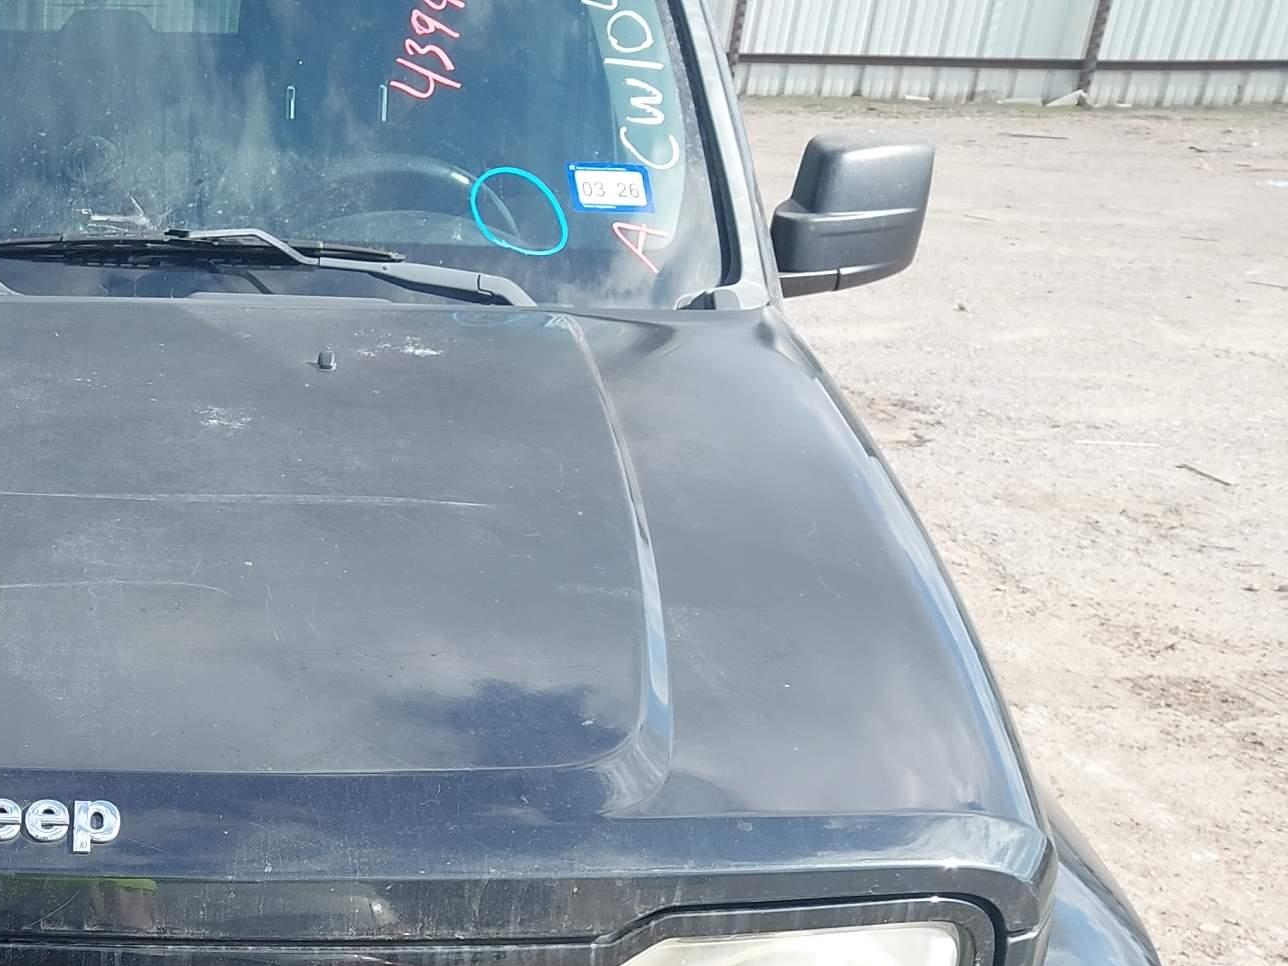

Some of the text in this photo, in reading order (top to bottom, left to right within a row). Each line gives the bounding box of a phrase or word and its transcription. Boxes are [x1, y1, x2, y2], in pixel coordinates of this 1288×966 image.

[389, 0, 465, 98] 439
[581, 0, 680, 169] CW10
[582, 182, 640, 198] 03 26
